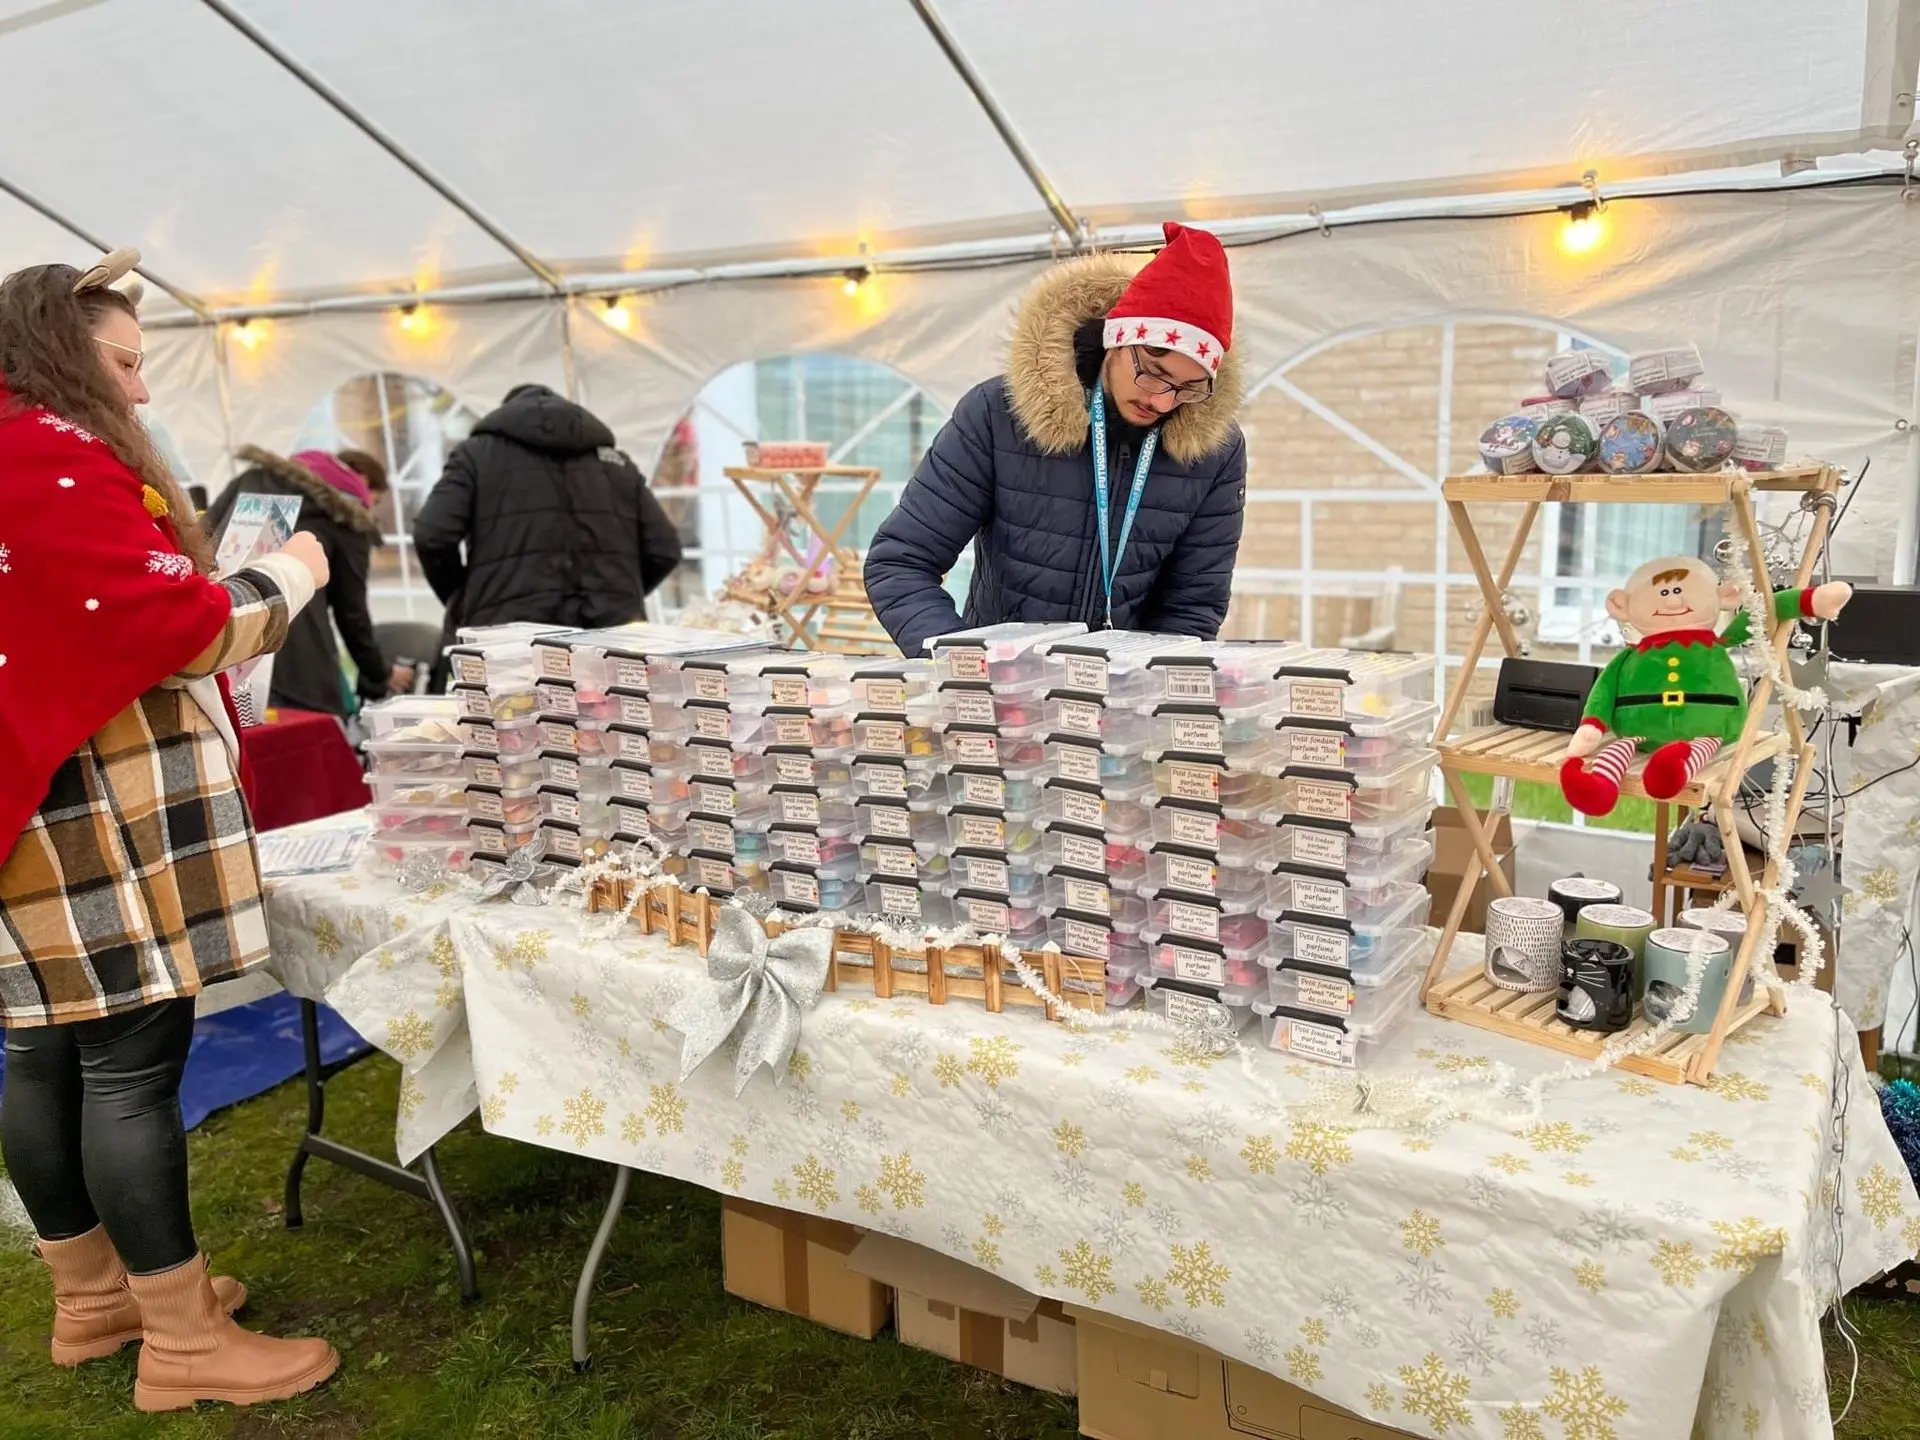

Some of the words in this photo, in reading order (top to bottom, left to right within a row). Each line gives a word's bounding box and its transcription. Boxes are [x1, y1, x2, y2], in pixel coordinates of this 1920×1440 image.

[1094, 421, 1106, 489] FUTUROSCOPE
[1191, 722, 1215, 730] fondant
[1293, 734, 1308, 742] Petit
[1309, 735, 1336, 745] fondant
[1300, 786, 1315, 795] Petit
[1316, 788, 1342, 797] fondant
[1296, 883, 1311, 891] Petit
[1313, 885, 1339, 895] fondant
[1299, 932, 1314, 941] Petit
[1315, 936, 1341, 945] fondant
[1178, 952, 1192, 960] Petit
[1193, 954, 1217, 963] fondant
[1301, 978, 1317, 987] Petit
[1317, 981, 1343, 992] fondant
[1294, 1025, 1309, 1033] Petit
[1310, 1028, 1335, 1039] fondant
